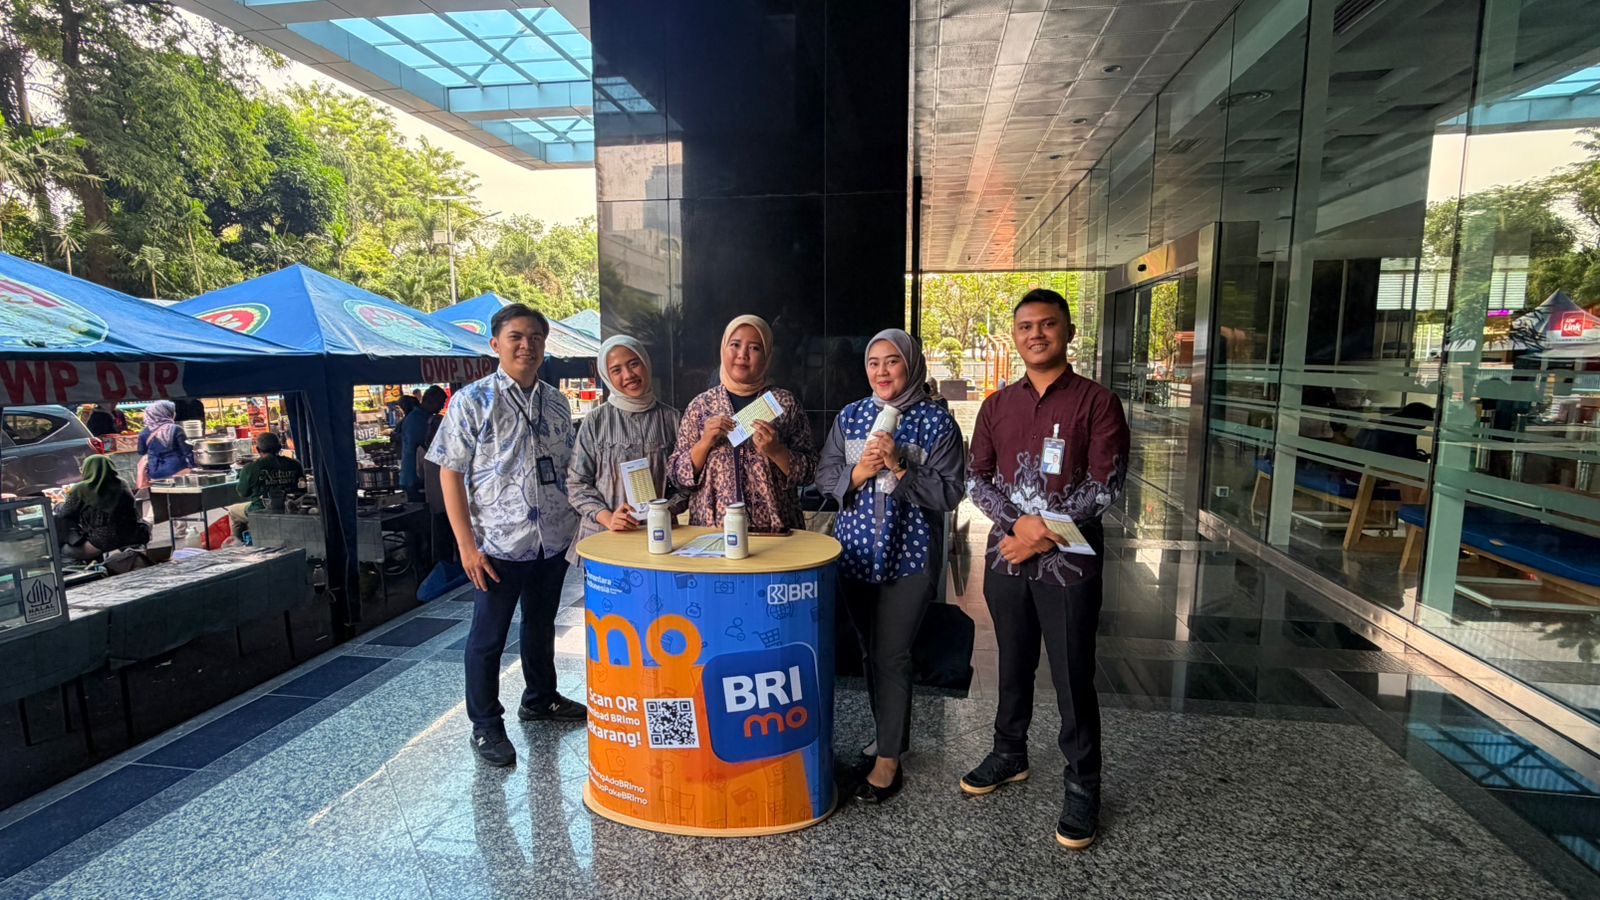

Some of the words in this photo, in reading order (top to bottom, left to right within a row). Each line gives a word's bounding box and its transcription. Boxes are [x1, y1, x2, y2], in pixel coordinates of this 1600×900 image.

[96, 360, 179, 401] DJP
[463, 357, 491, 381] DJP
[788, 581, 818, 602] BRI
[28, 603, 55, 613] HALAL
[585, 609, 702, 670] mo
[722, 665, 803, 713] BRI
[615, 695, 639, 713] QR
[743, 706, 808, 738] mo
